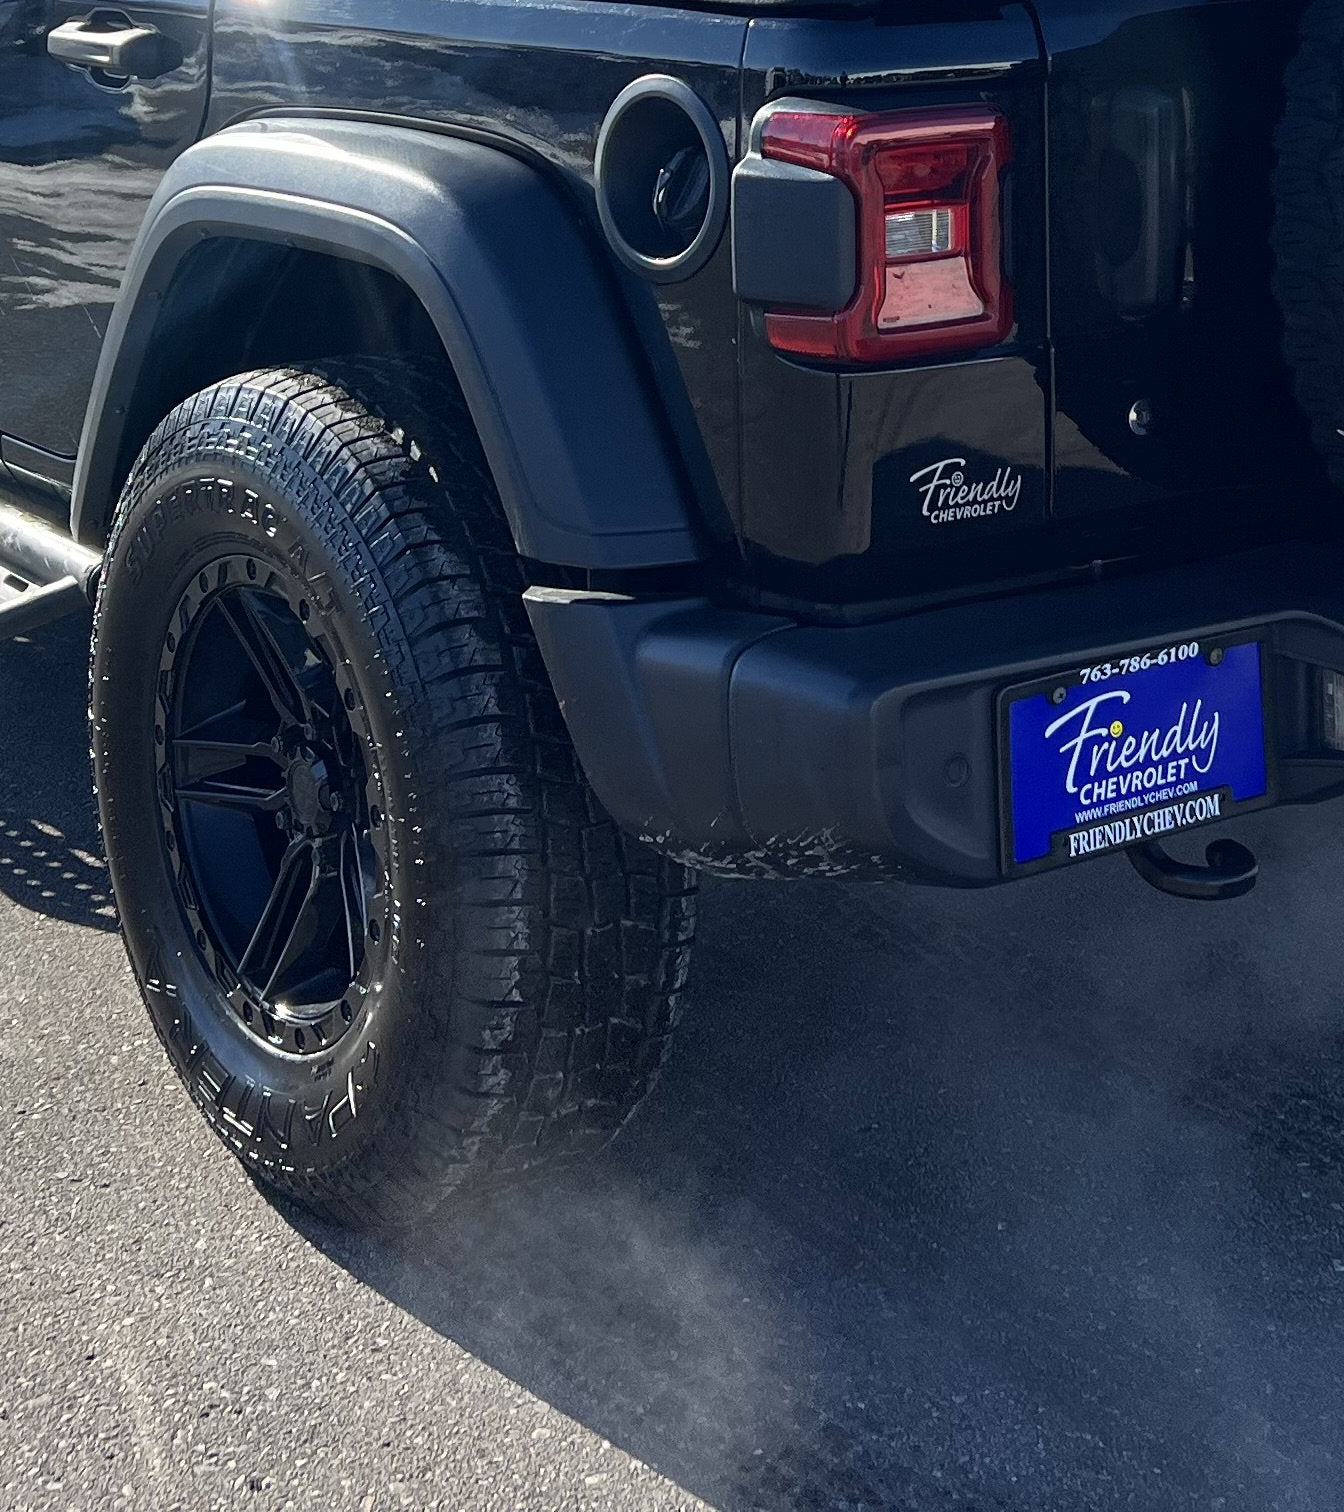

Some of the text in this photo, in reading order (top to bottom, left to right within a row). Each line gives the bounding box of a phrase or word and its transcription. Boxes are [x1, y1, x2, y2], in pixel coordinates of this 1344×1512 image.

[909, 457, 1022, 517] Friendly
[930, 500, 1002, 524] CHEVROLET
[1079, 641, 1199, 685] 763-786-6100
[1044, 690, 1219, 794] Friendly
[1074, 780, 1199, 824] WWW.FRIENDLYCHEV.COM
[1079, 757, 1190, 806] CHEVROLET
[1068, 793, 1221, 858] FRIENDLYCHEV.COM
